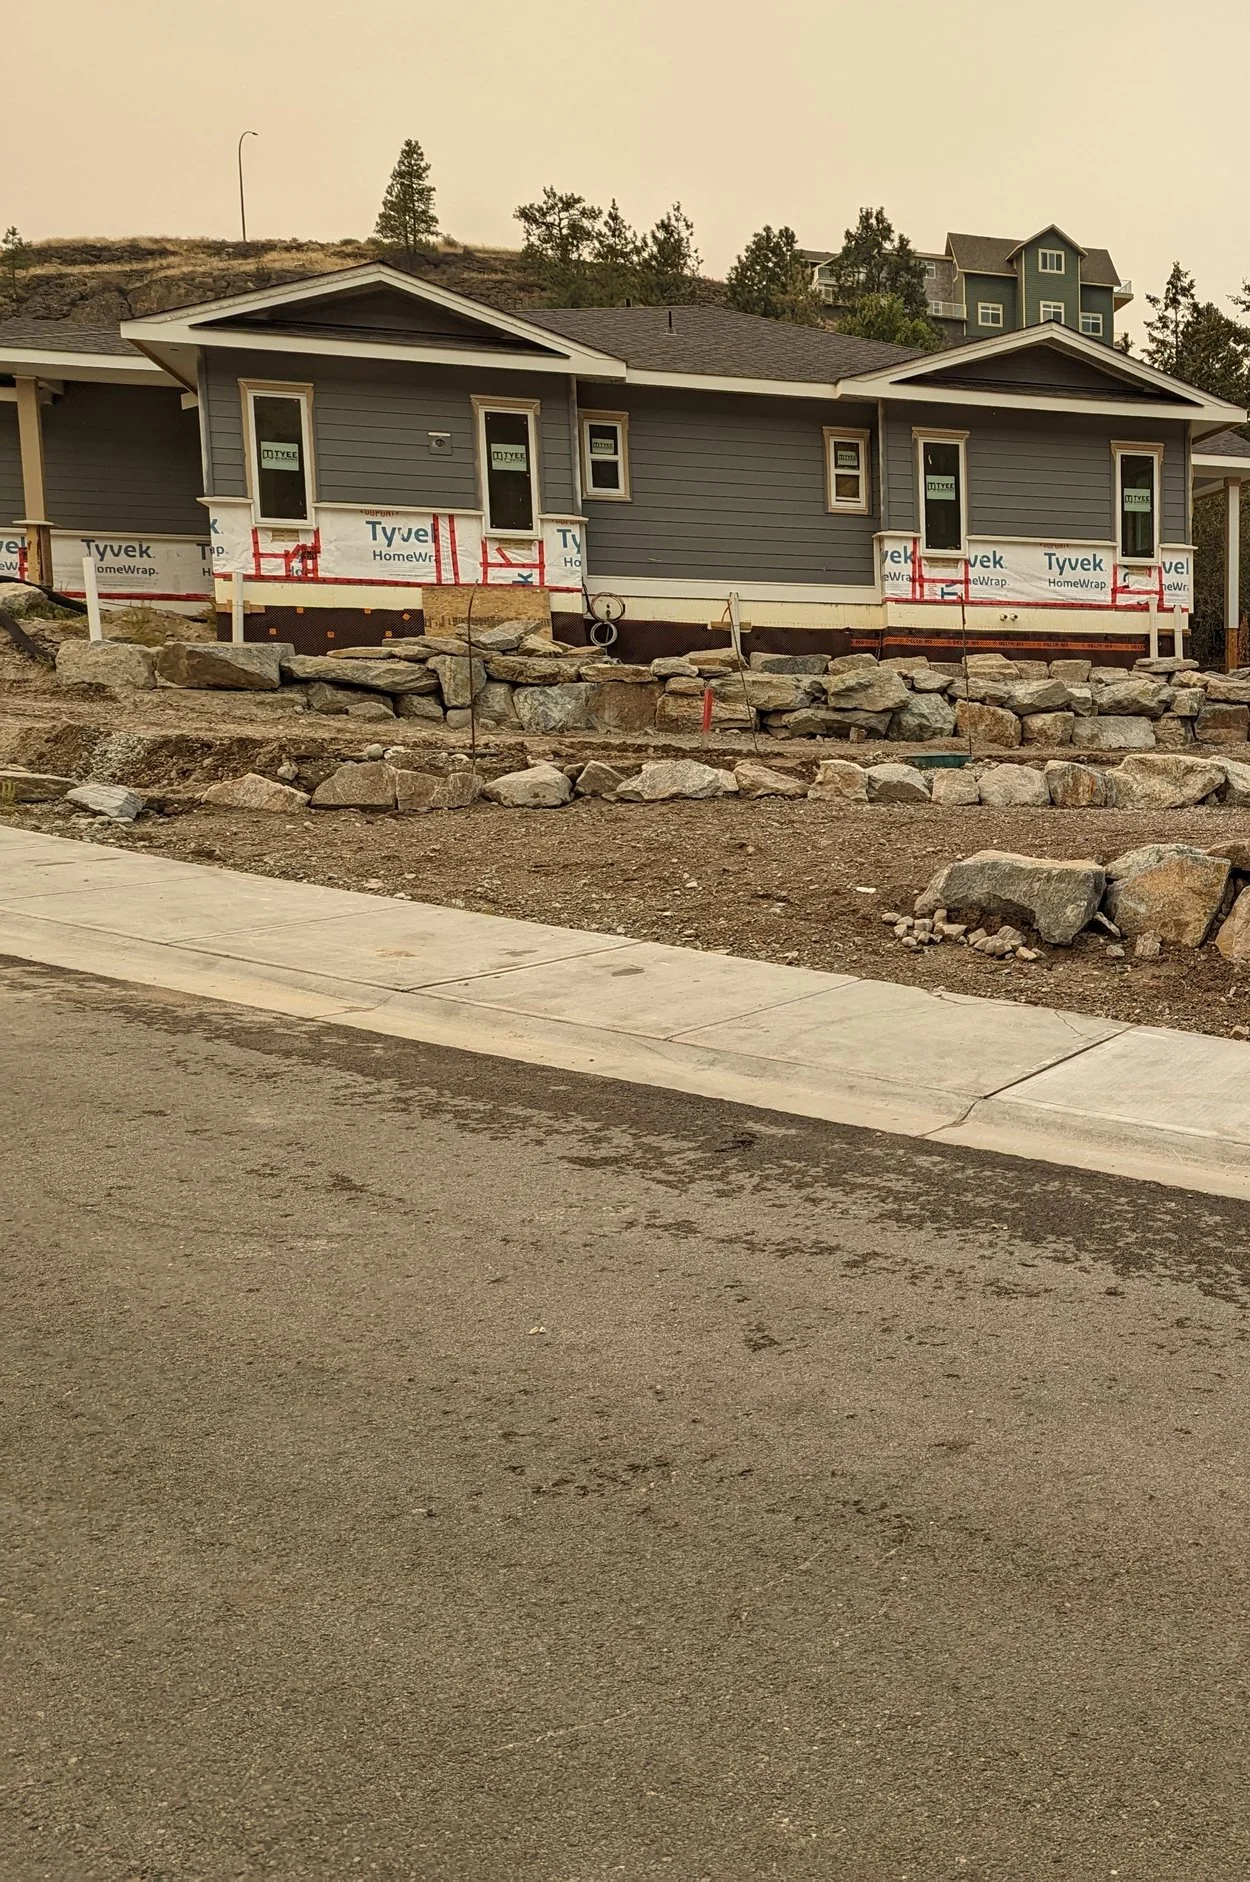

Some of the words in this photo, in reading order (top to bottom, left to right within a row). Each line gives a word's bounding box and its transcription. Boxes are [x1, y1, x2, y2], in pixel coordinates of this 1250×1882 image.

[274, 450, 298, 459] TYEE
[81, 539, 153, 562] Tyvek
[373, 550, 436, 563] HomeWr
[1044, 552, 1104, 576] Tyvek
[1048, 578, 1106, 591] HomeWrap
